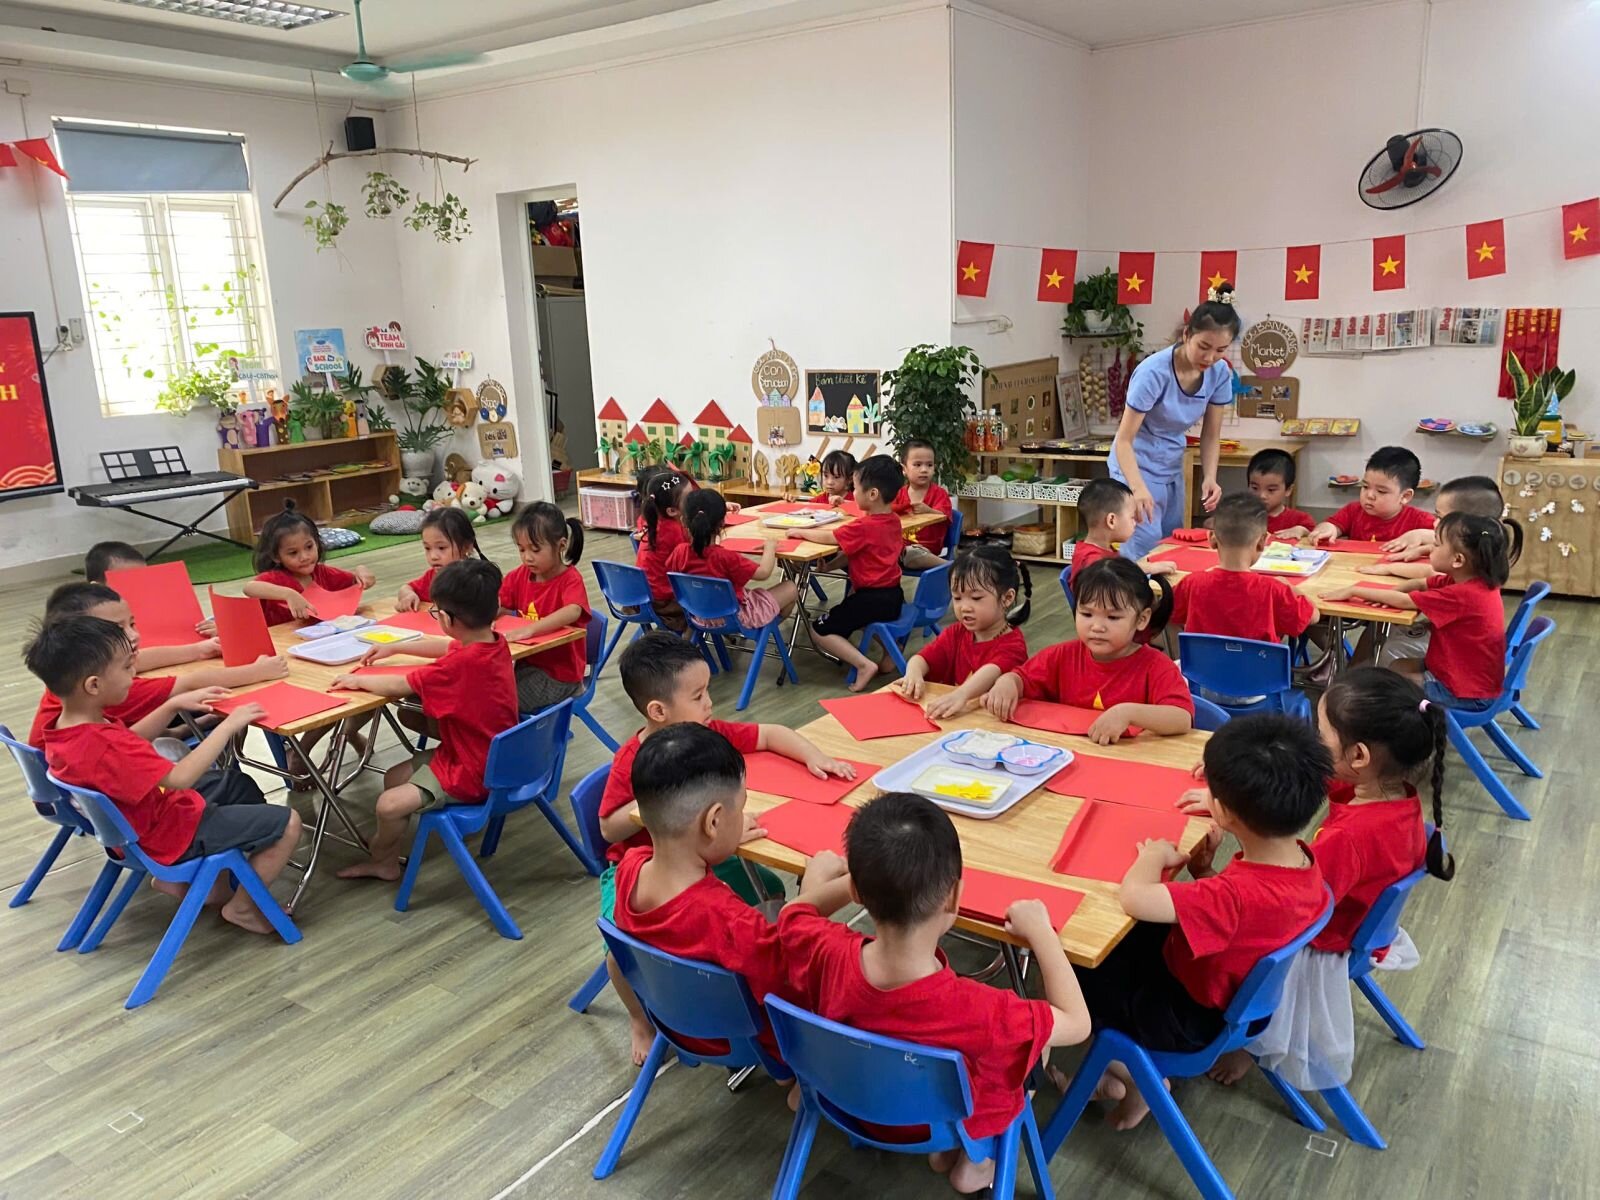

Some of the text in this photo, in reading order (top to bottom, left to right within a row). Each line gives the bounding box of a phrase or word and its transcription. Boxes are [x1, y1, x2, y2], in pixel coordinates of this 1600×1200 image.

[380, 333, 400, 341] TEAM
[1251, 343, 1285, 357] Market
[314, 362, 343, 370] SCHOOL
